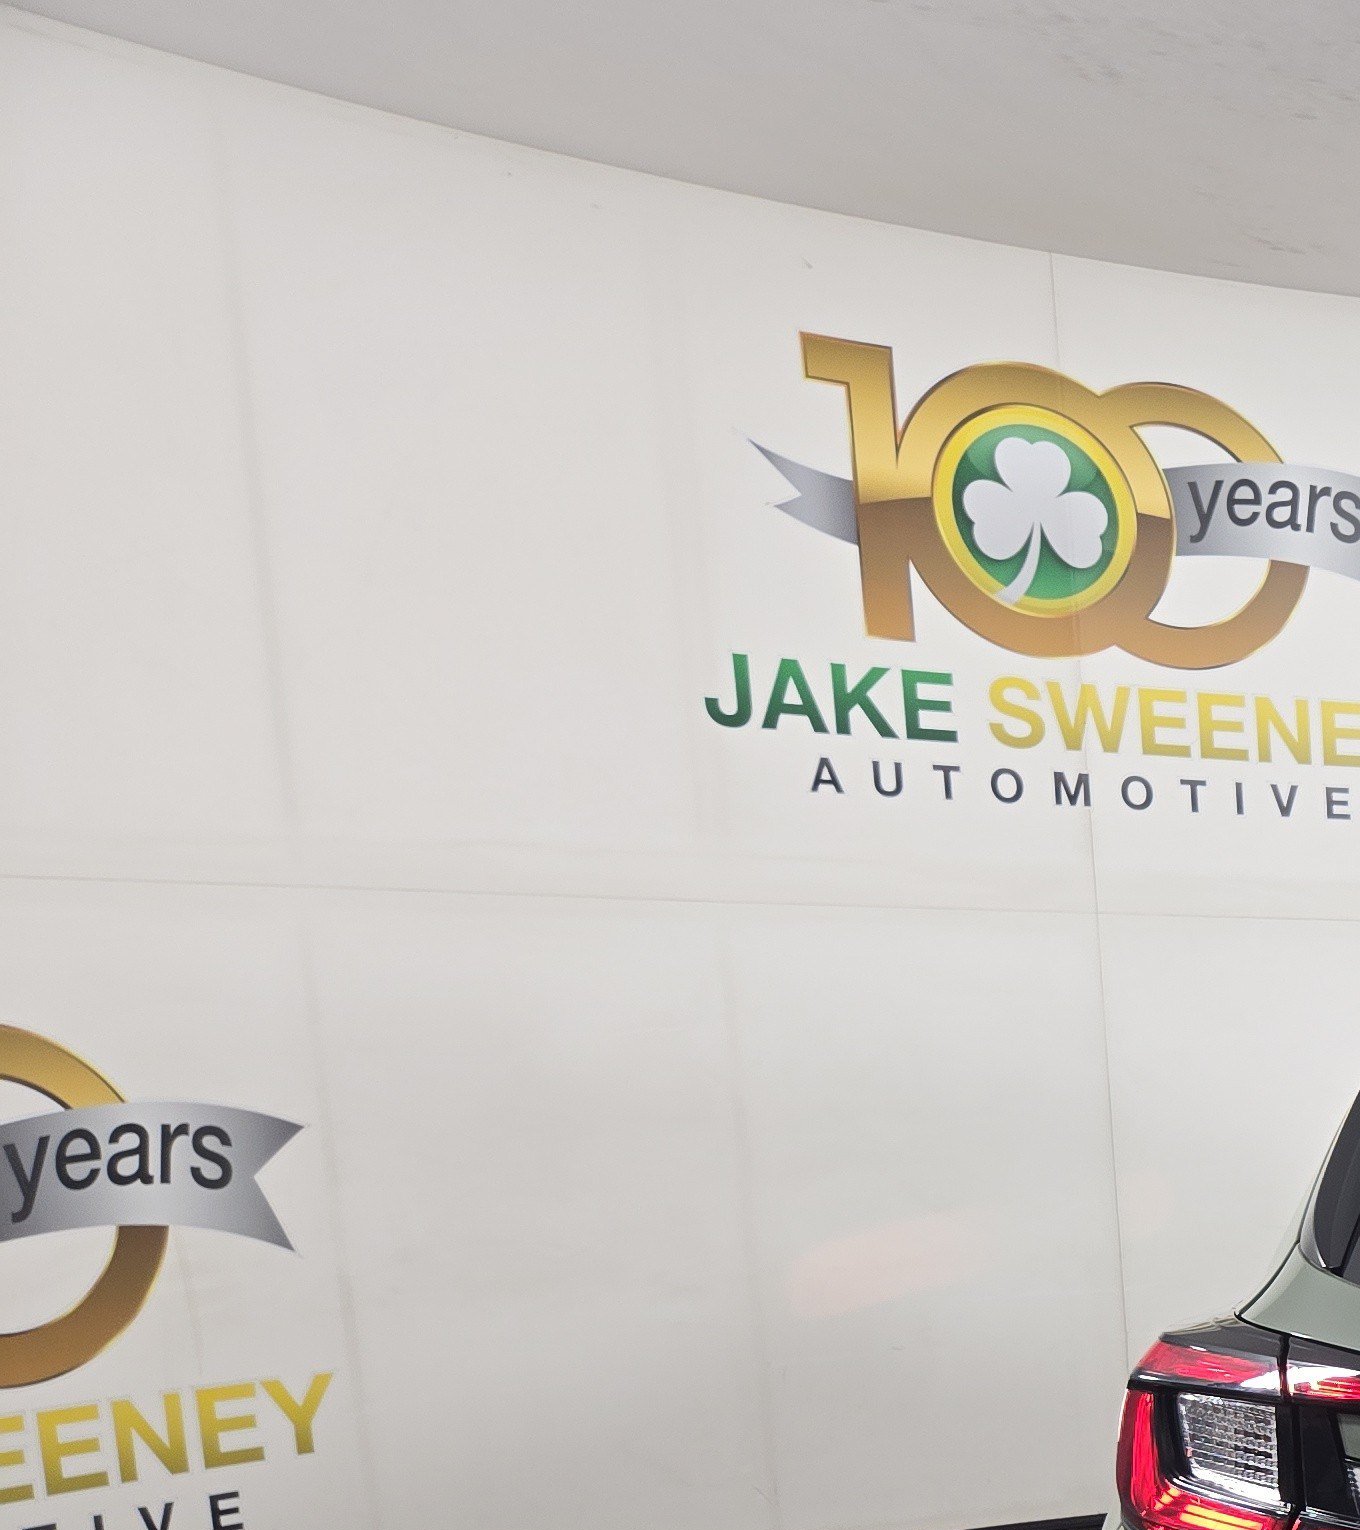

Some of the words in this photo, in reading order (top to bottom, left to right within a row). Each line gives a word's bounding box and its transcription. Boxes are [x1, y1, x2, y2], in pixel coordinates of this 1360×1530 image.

[799, 331, 1310, 671] 100
[704, 652, 959, 743] JAKE
[811, 756, 1353, 820] AUTOMOTIVE
[3, 1121, 233, 1223] years
